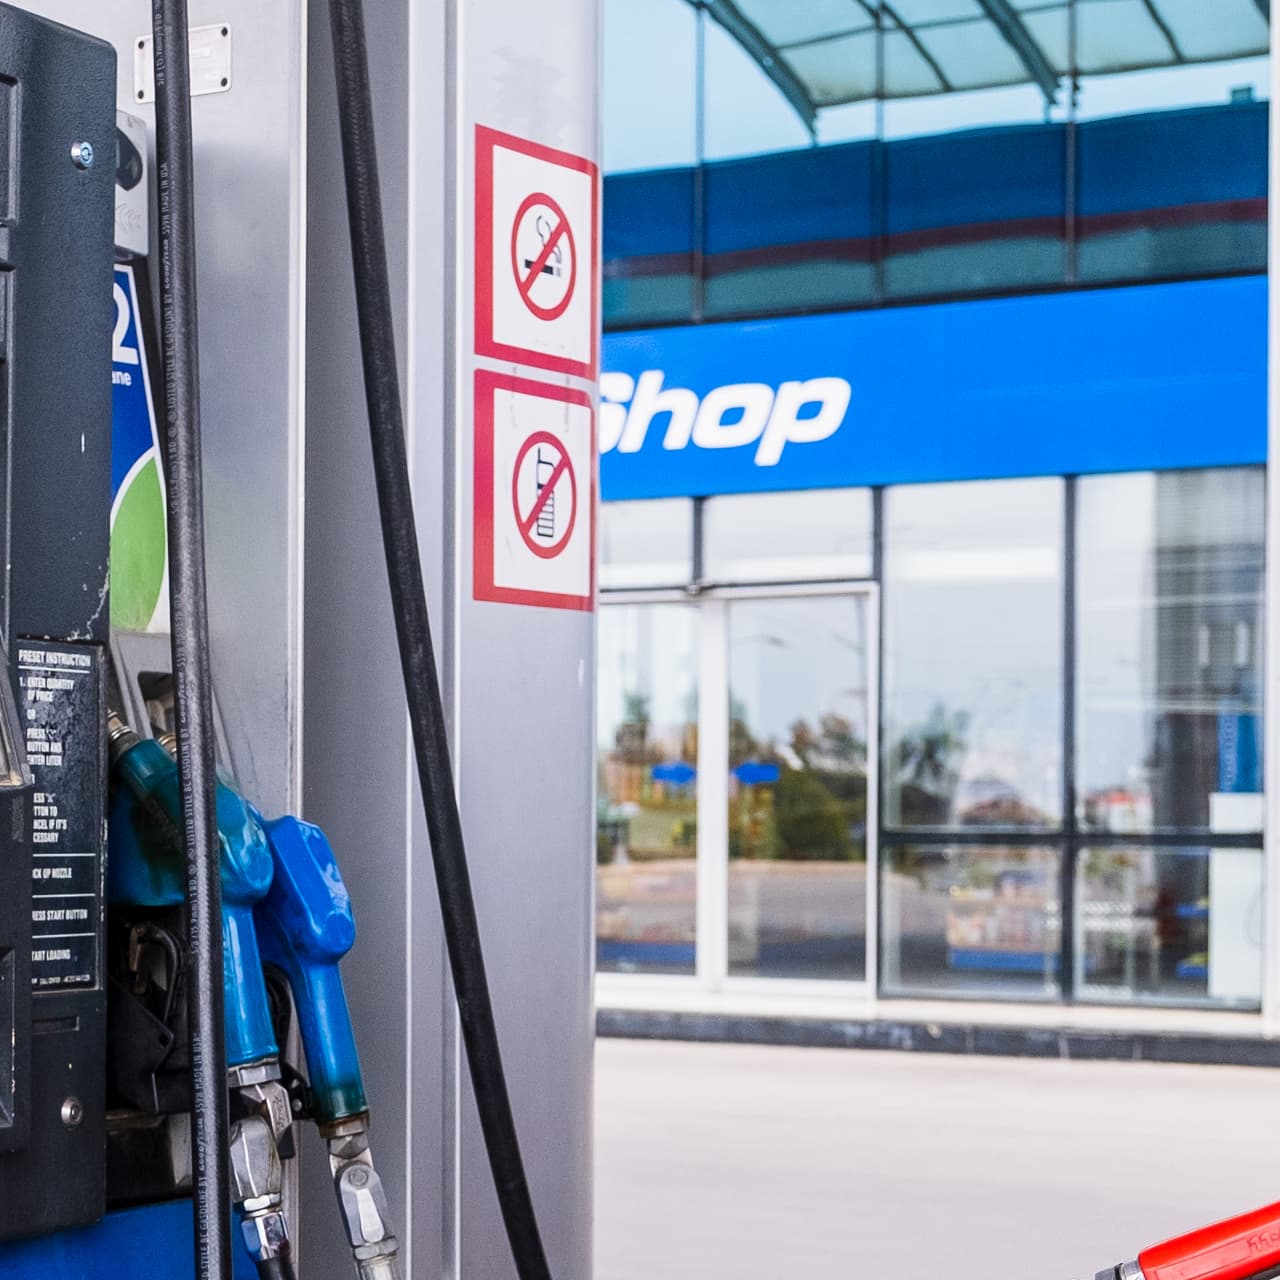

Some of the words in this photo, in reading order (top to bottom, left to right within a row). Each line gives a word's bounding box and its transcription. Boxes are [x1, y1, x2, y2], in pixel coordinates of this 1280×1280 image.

[599, 370, 852, 467] Shop
[18, 649, 45, 663] PRESET
[45, 651, 91, 667] INSTRUCTION
[47, 910, 65, 921] START
[66, 909, 88, 920] BUTTON
[46, 949, 71, 960] LOADING
[194, 1068, 203, 1089] MADE
[199, 1190, 208, 1230] GASOLINE
